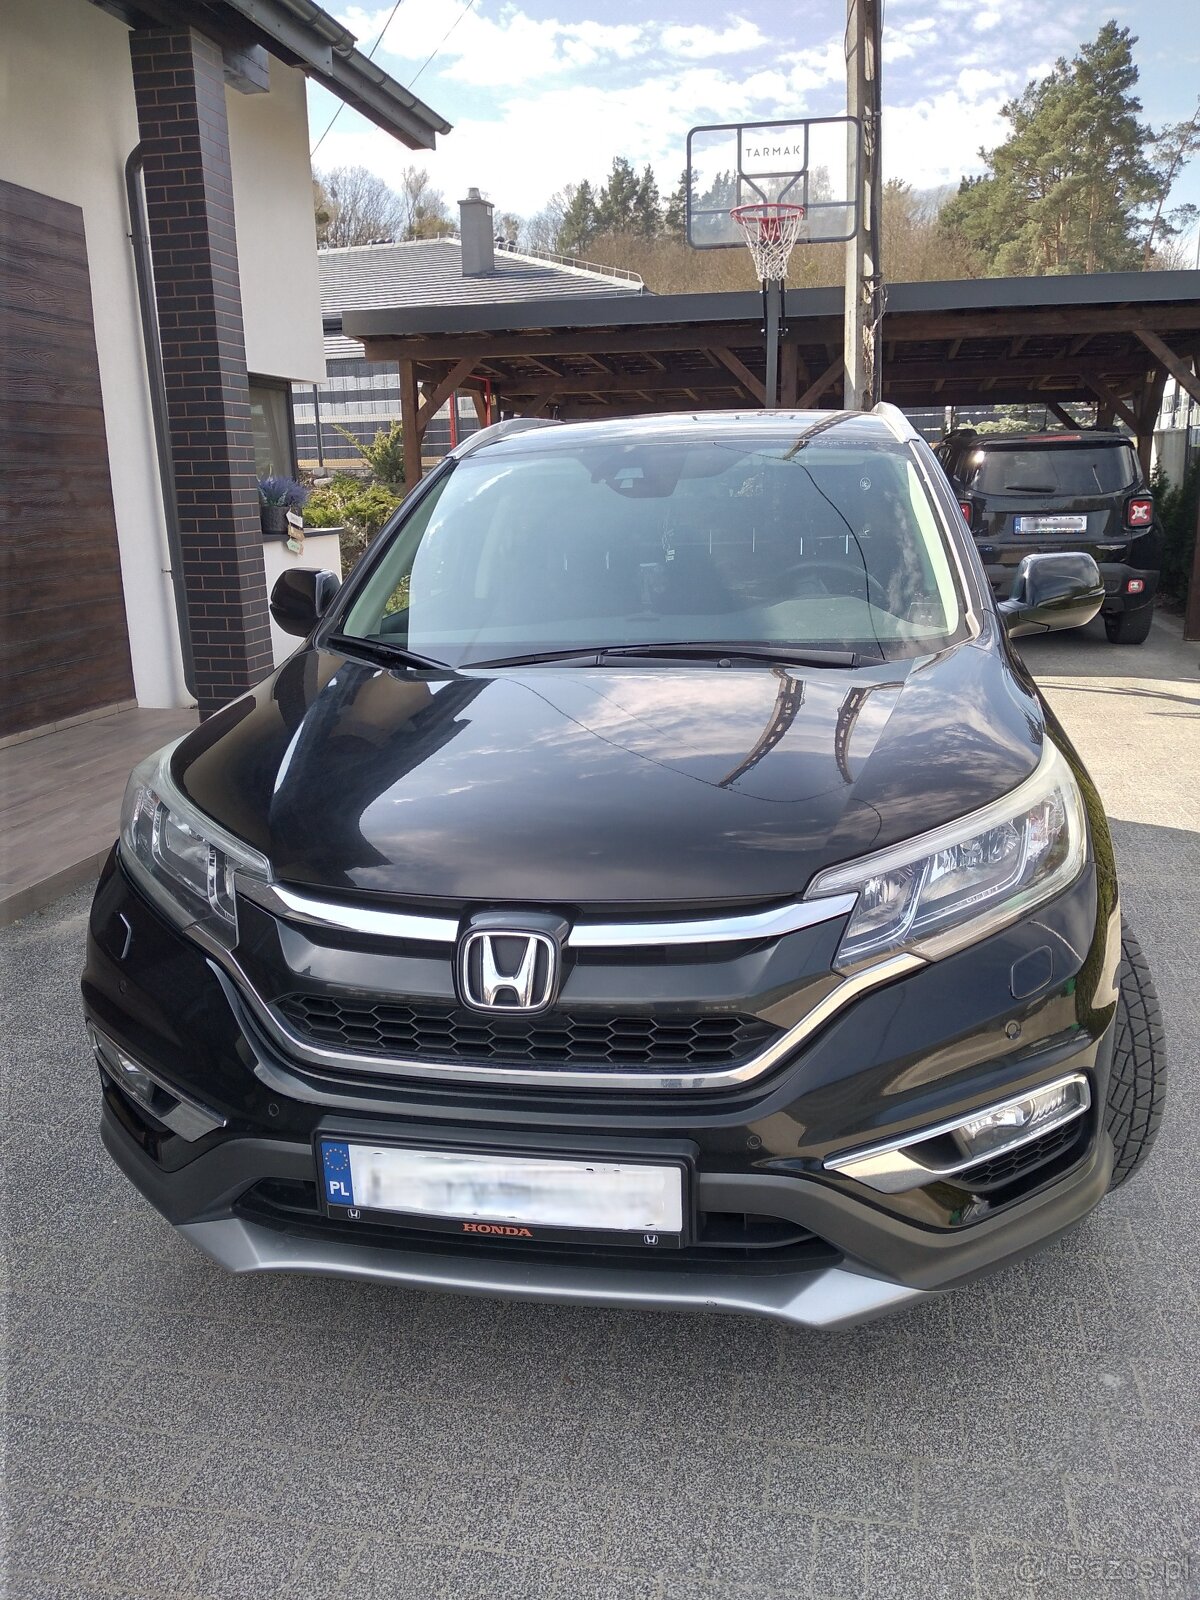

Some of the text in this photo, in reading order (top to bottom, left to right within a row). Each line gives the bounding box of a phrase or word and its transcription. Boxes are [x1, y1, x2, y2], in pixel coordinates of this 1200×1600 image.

[745, 145, 801, 157] TARMAK
[329, 1180, 350, 1197] PL
[462, 1223, 533, 1238] HONDA
